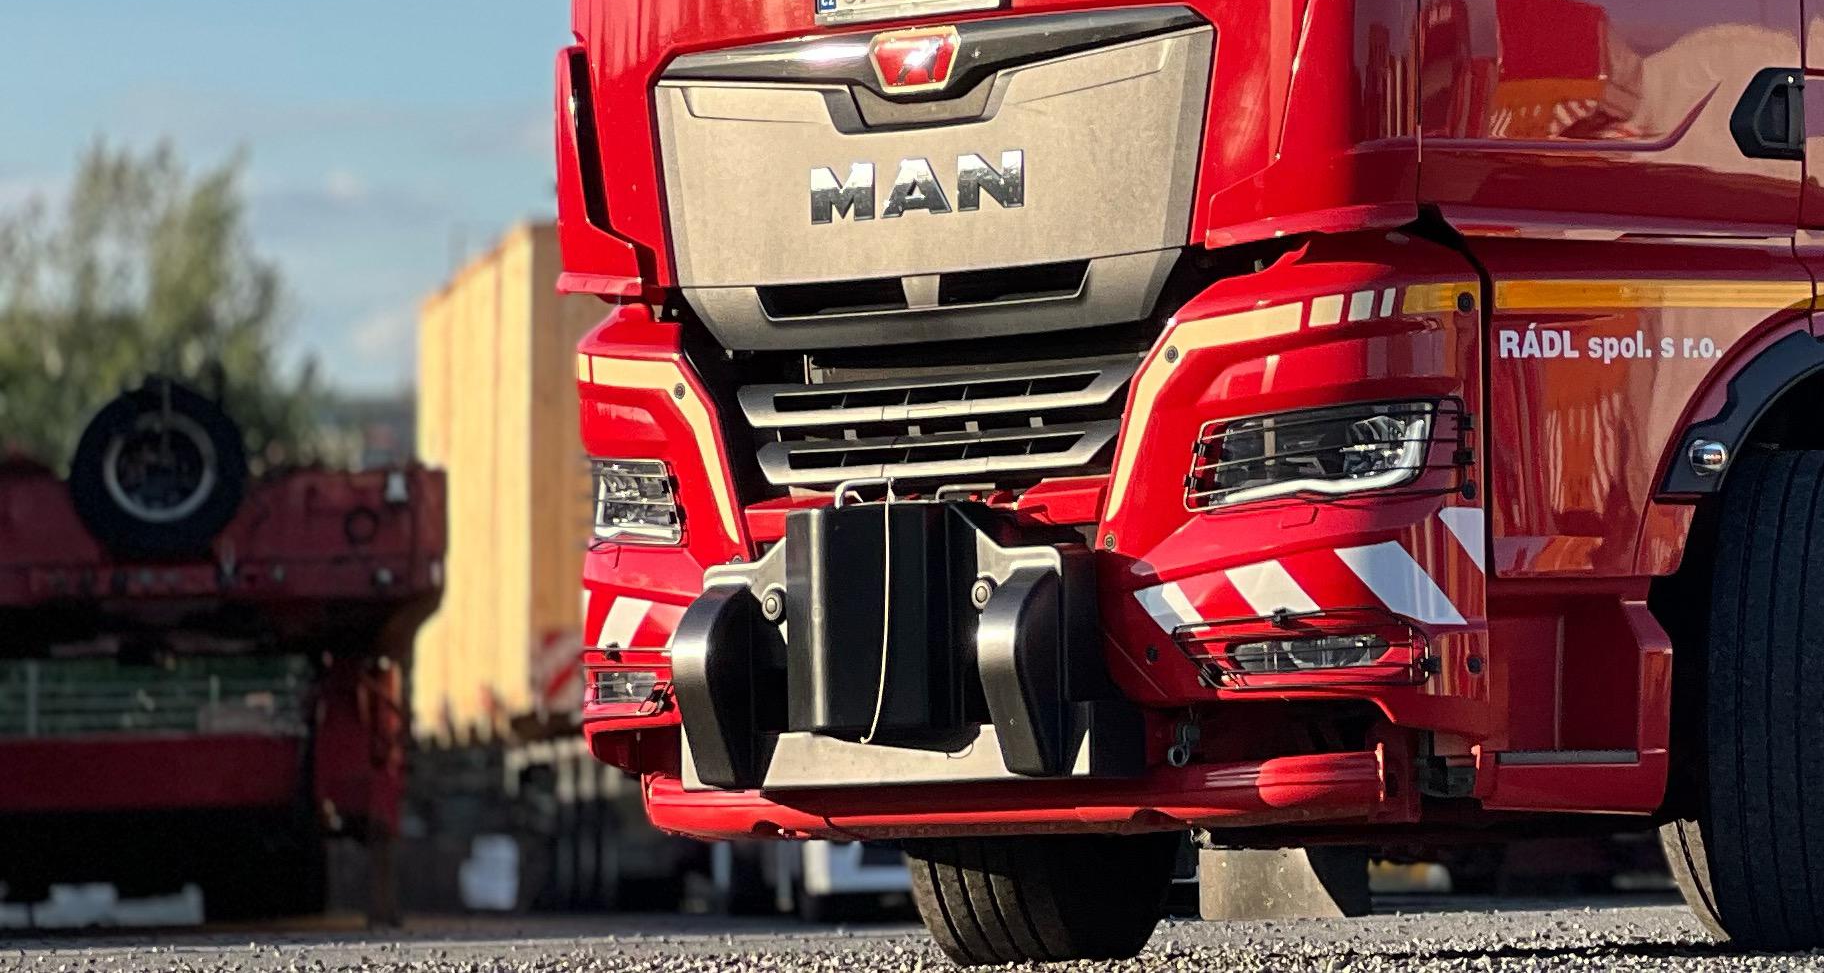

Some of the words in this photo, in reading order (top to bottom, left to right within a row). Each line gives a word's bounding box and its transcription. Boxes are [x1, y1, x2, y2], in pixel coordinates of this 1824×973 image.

[810, 149, 1025, 225] MAN
[1500, 322, 1579, 358] RÁDL
[1588, 329, 1652, 365] spol.
[1660, 336, 1674, 358] s
[1683, 337, 1723, 358] r.o.
